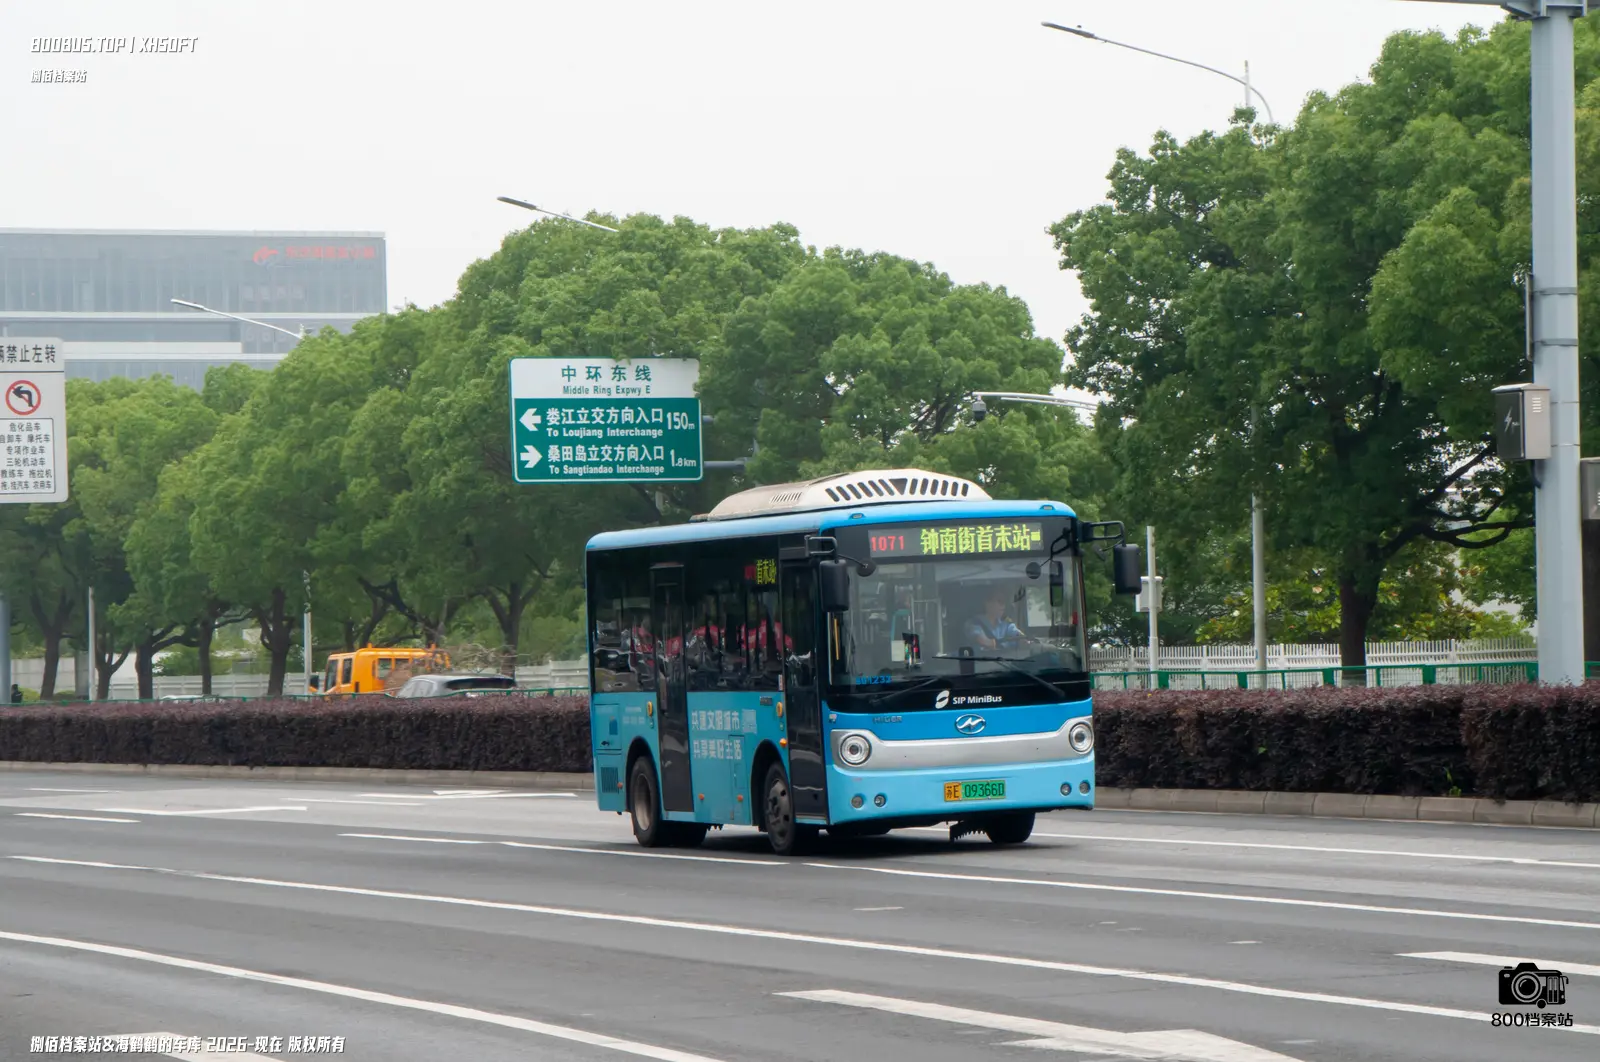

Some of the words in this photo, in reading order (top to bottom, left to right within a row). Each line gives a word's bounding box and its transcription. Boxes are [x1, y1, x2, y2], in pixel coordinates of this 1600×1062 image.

[561, 365, 652, 382] 中环东线
[563, 386, 590, 394] Middle
[593, 386, 612, 396] Ring
[616, 386, 642, 396] Expwy
[646, 386, 650, 394] E
[546, 408, 663, 425] 娄江立交方向入口
[667, 412, 695, 430] 150m
[547, 428, 559, 437] To
[563, 428, 603, 438] Loujiang
[607, 428, 663, 438] Interchange
[547, 445, 665, 462] 桑田岛立交方向入口
[550, 465, 560, 474] To
[563, 464, 613, 476] Sangtiandao
[617, 465, 664, 476] Interchange
[870, 536, 905, 551] 1071
[920, 524, 1031, 555] 钟南街首末站
[953, 696, 966, 704] SIP
[967, 694, 1002, 704] MiniBus
